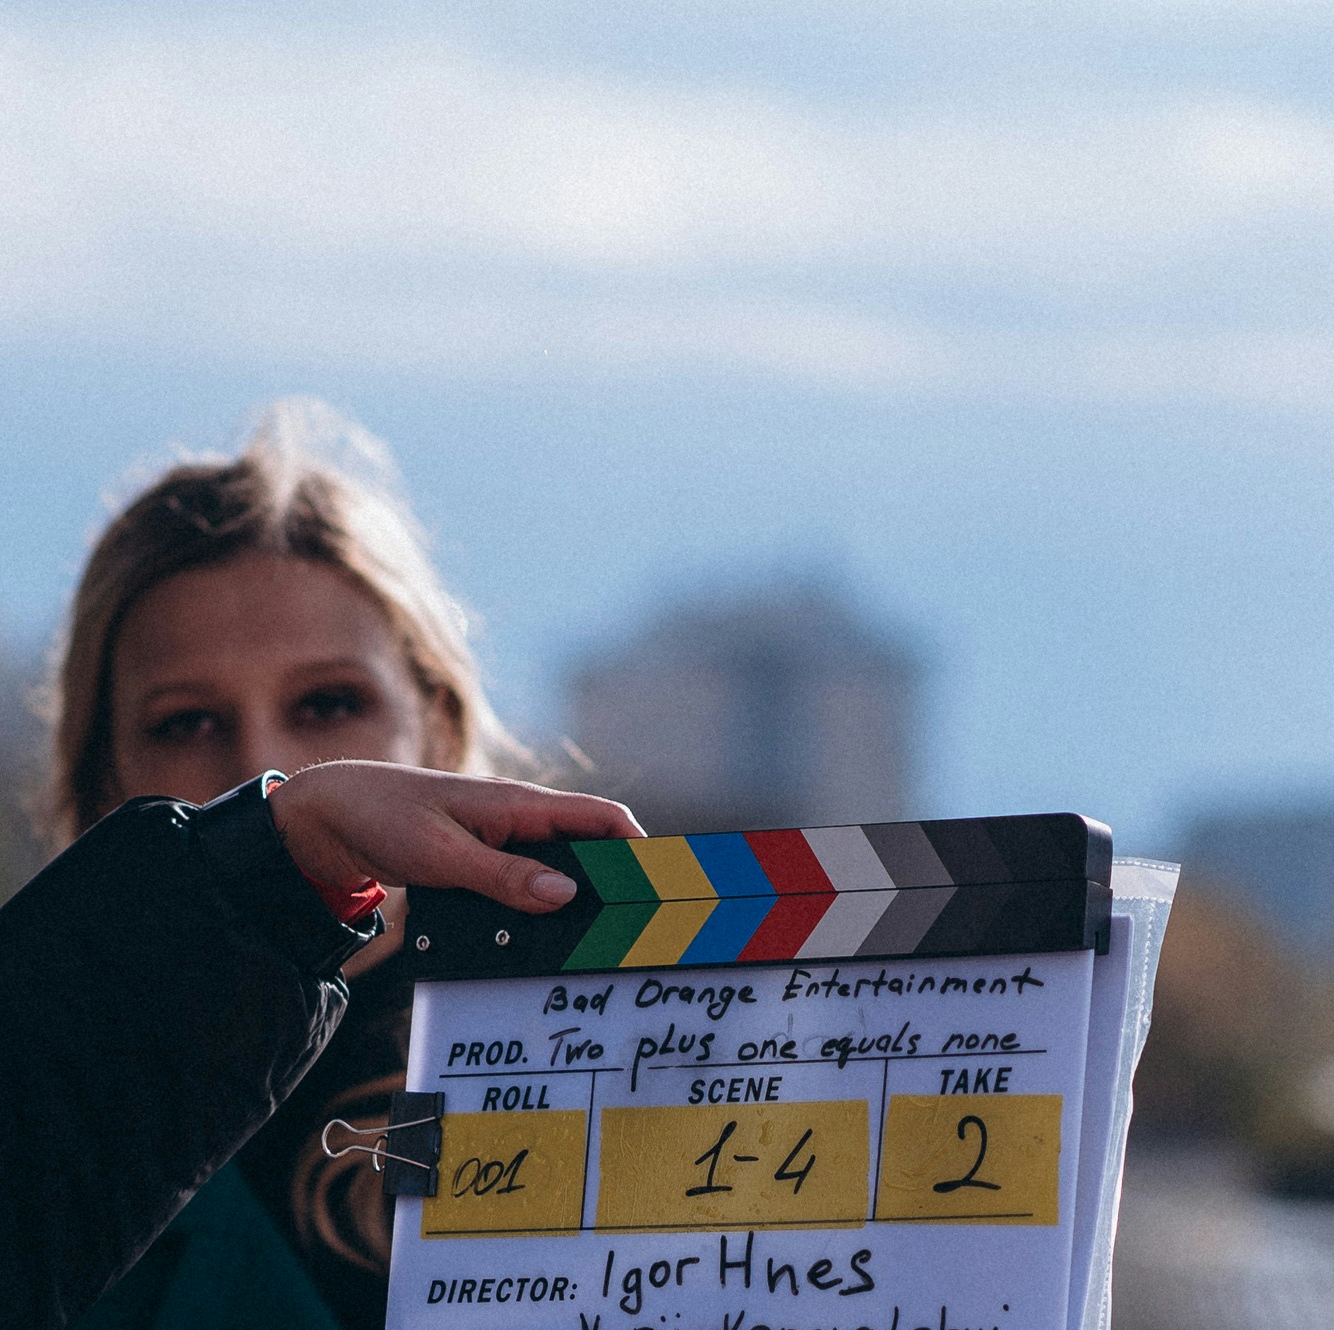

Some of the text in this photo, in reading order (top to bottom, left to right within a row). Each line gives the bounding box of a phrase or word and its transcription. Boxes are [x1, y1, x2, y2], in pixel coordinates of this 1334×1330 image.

[543, 967, 1045, 1020] Bad Orange Entertainment
[447, 1041, 528, 1066] PROD.
[548, 1027, 604, 1066] Two
[737, 1039, 798, 1061] one
[820, 1021, 921, 1069] equals
[941, 1032, 1021, 1053] none
[482, 1085, 550, 1111] ROLL
[688, 1076, 782, 1104] SCENE
[940, 1066, 1013, 1095] TAKE
[932, 1115, 1002, 1193] 2
[451, 1149, 529, 1198] 001
[426, 1276, 578, 1304] DIRECTOR:
[602, 1250, 700, 1315] Igor
